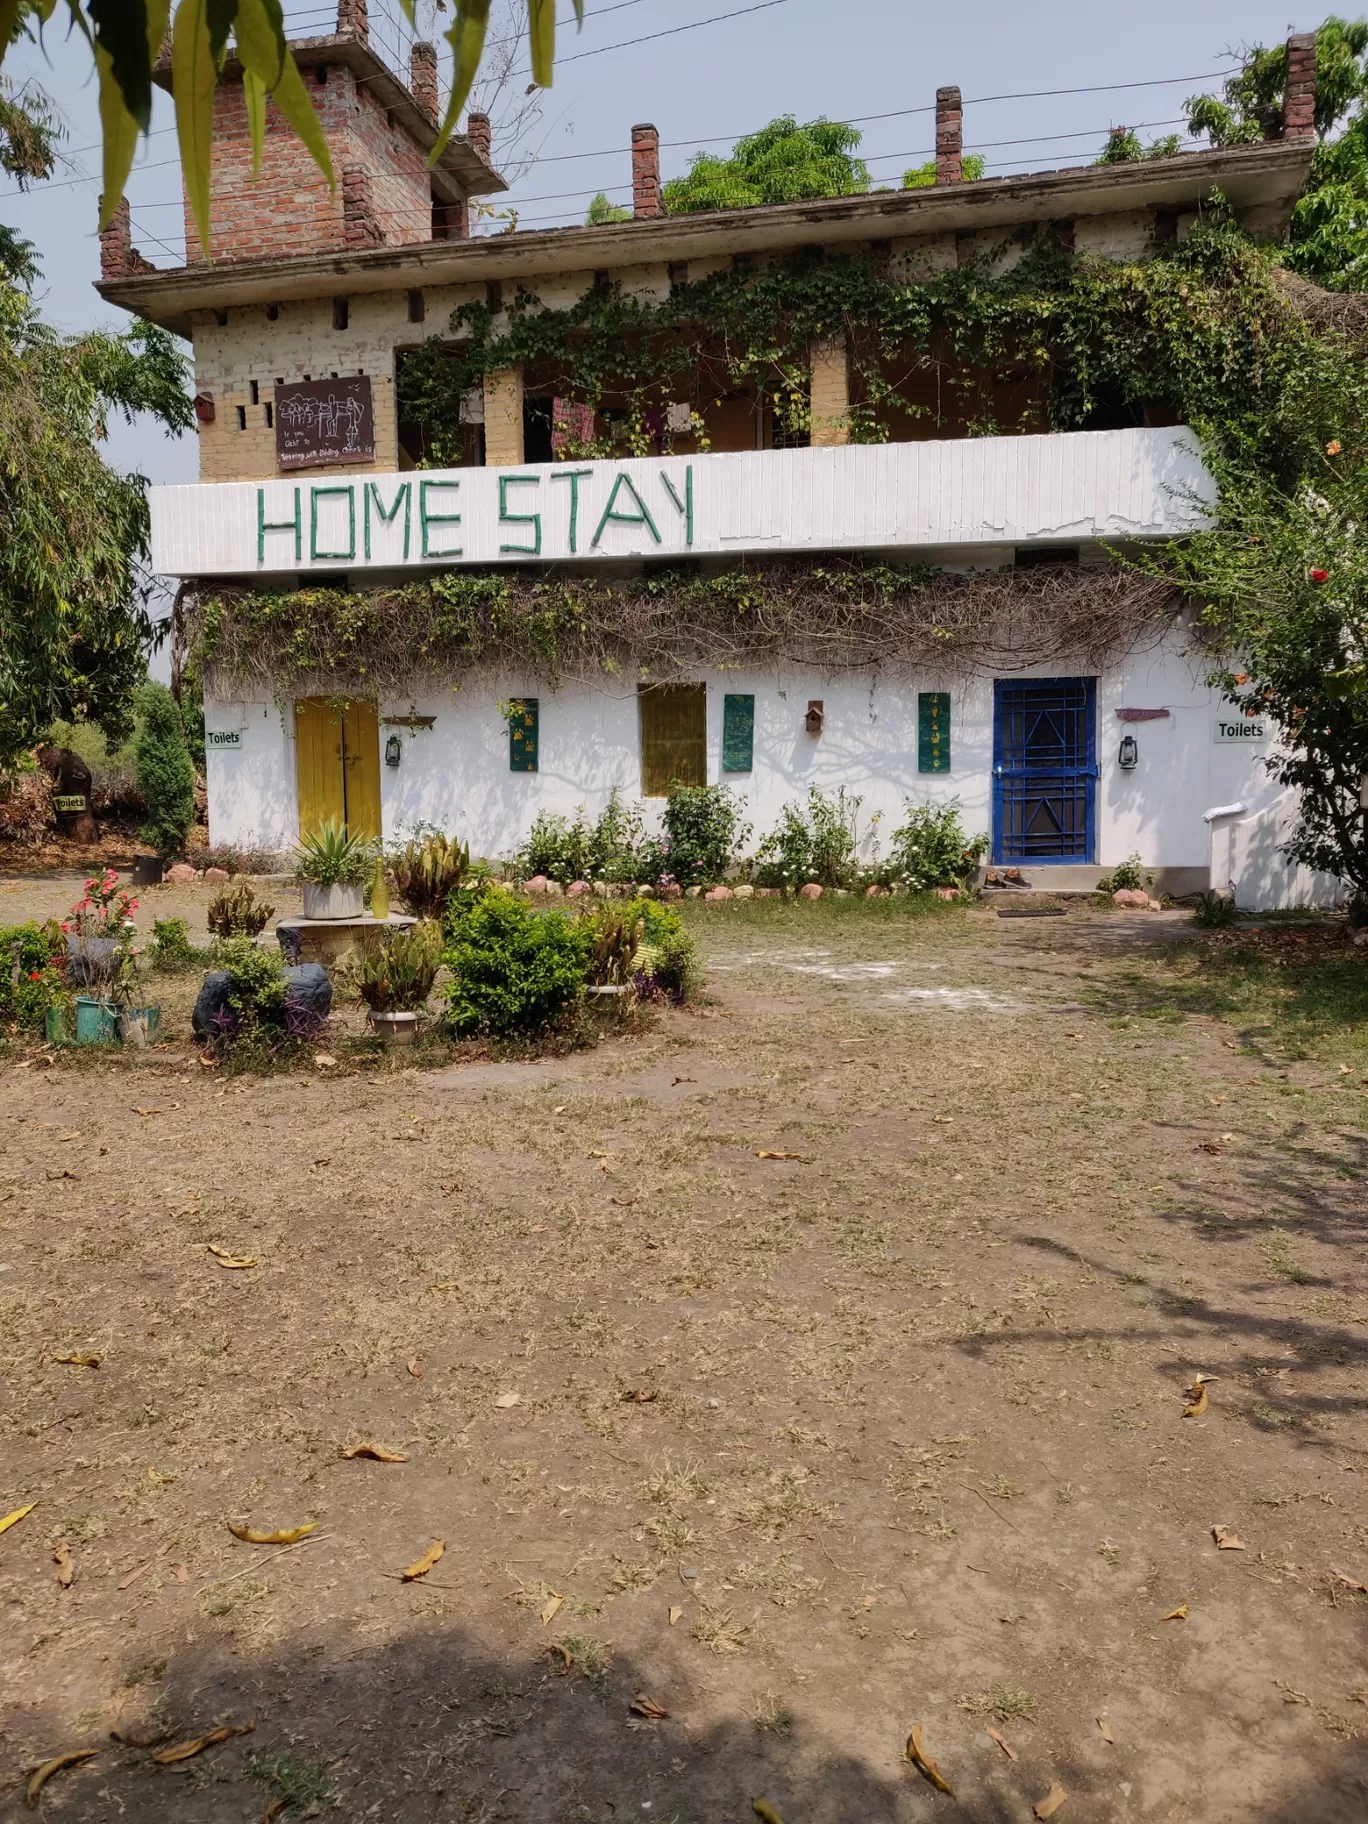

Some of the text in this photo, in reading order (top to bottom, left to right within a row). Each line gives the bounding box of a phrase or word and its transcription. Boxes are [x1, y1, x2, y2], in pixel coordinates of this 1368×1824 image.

[257, 464, 694, 562] HOME STAY
[1218, 722, 1264, 737] Toilets
[207, 731, 240, 744] Toilets
[54, 797, 84, 808] Toilets
